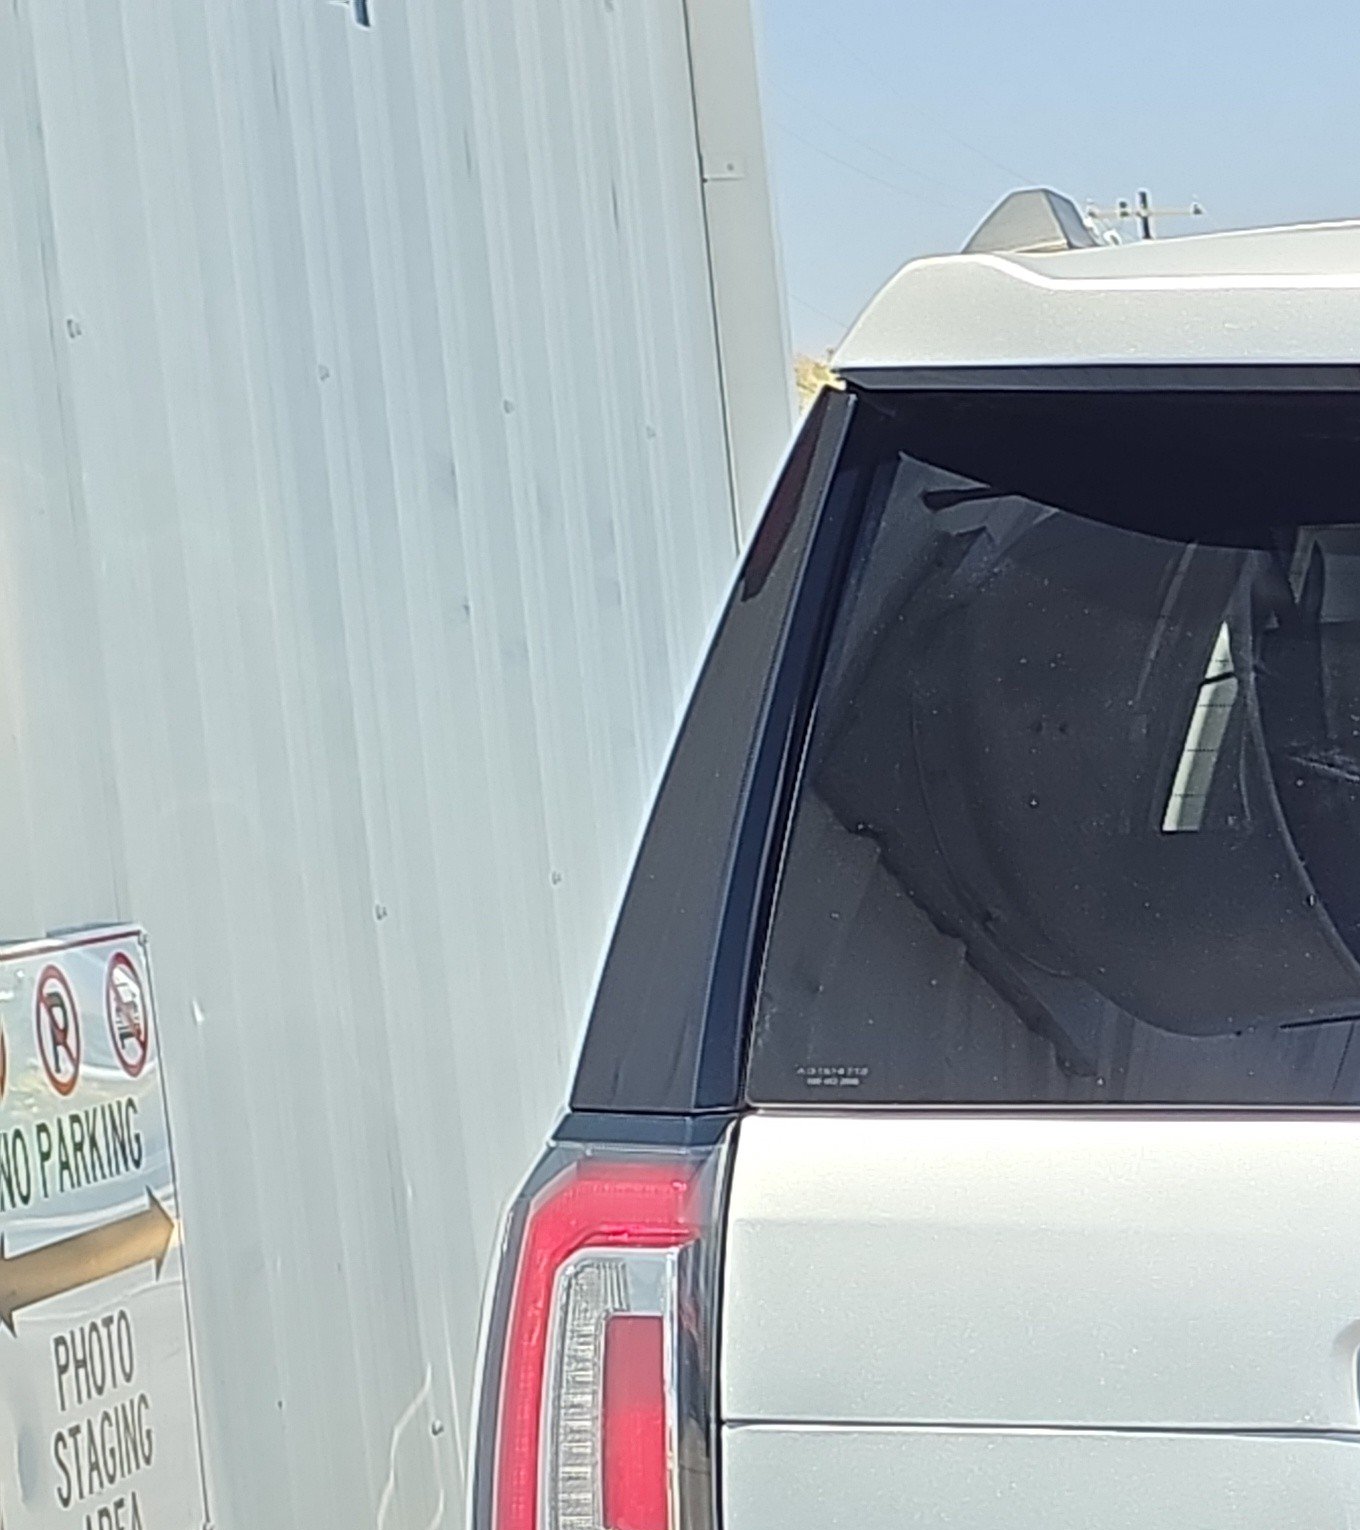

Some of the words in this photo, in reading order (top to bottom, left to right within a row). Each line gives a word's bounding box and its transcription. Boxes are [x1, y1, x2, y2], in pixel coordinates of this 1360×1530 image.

[0, 1128, 31, 1212] NO
[36, 1097, 142, 1198] PARKING
[53, 1310, 134, 1411] PHOTO
[54, 1393, 153, 1508] STAGING
